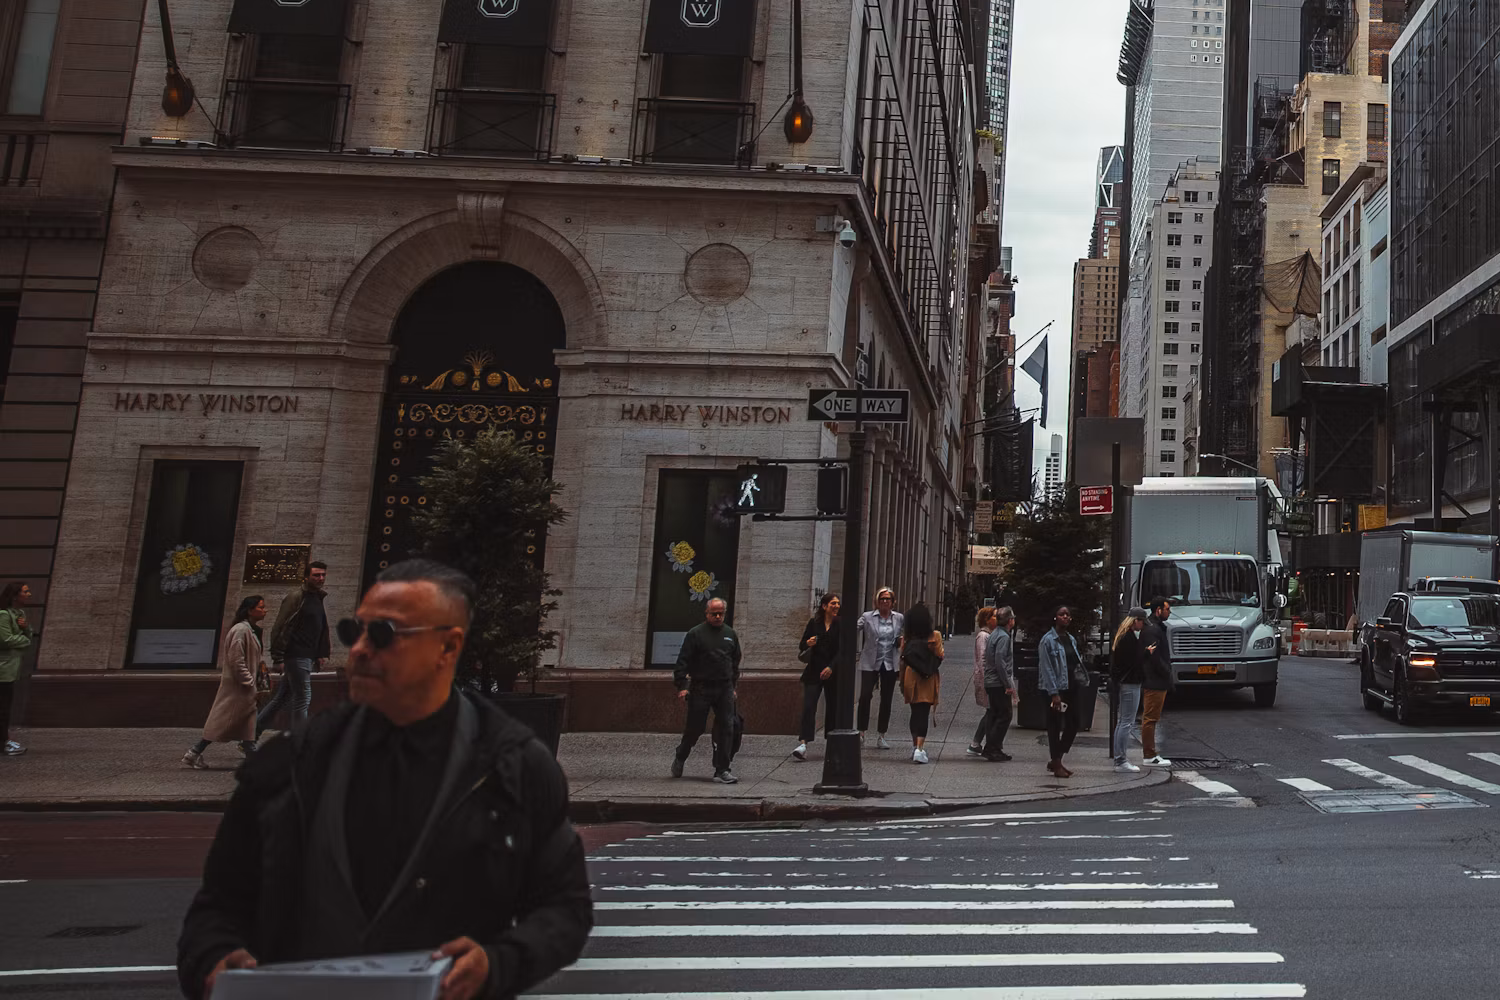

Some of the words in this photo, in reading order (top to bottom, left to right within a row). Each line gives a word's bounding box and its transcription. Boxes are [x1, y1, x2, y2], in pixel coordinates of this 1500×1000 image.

[115, 391, 192, 412] HARRY
[199, 393, 299, 413] WINSTON
[823, 398, 852, 412] ONE
[866, 399, 896, 412] WAY
[620, 403, 691, 422] HARRY
[697, 404, 791, 424] WINSTON
